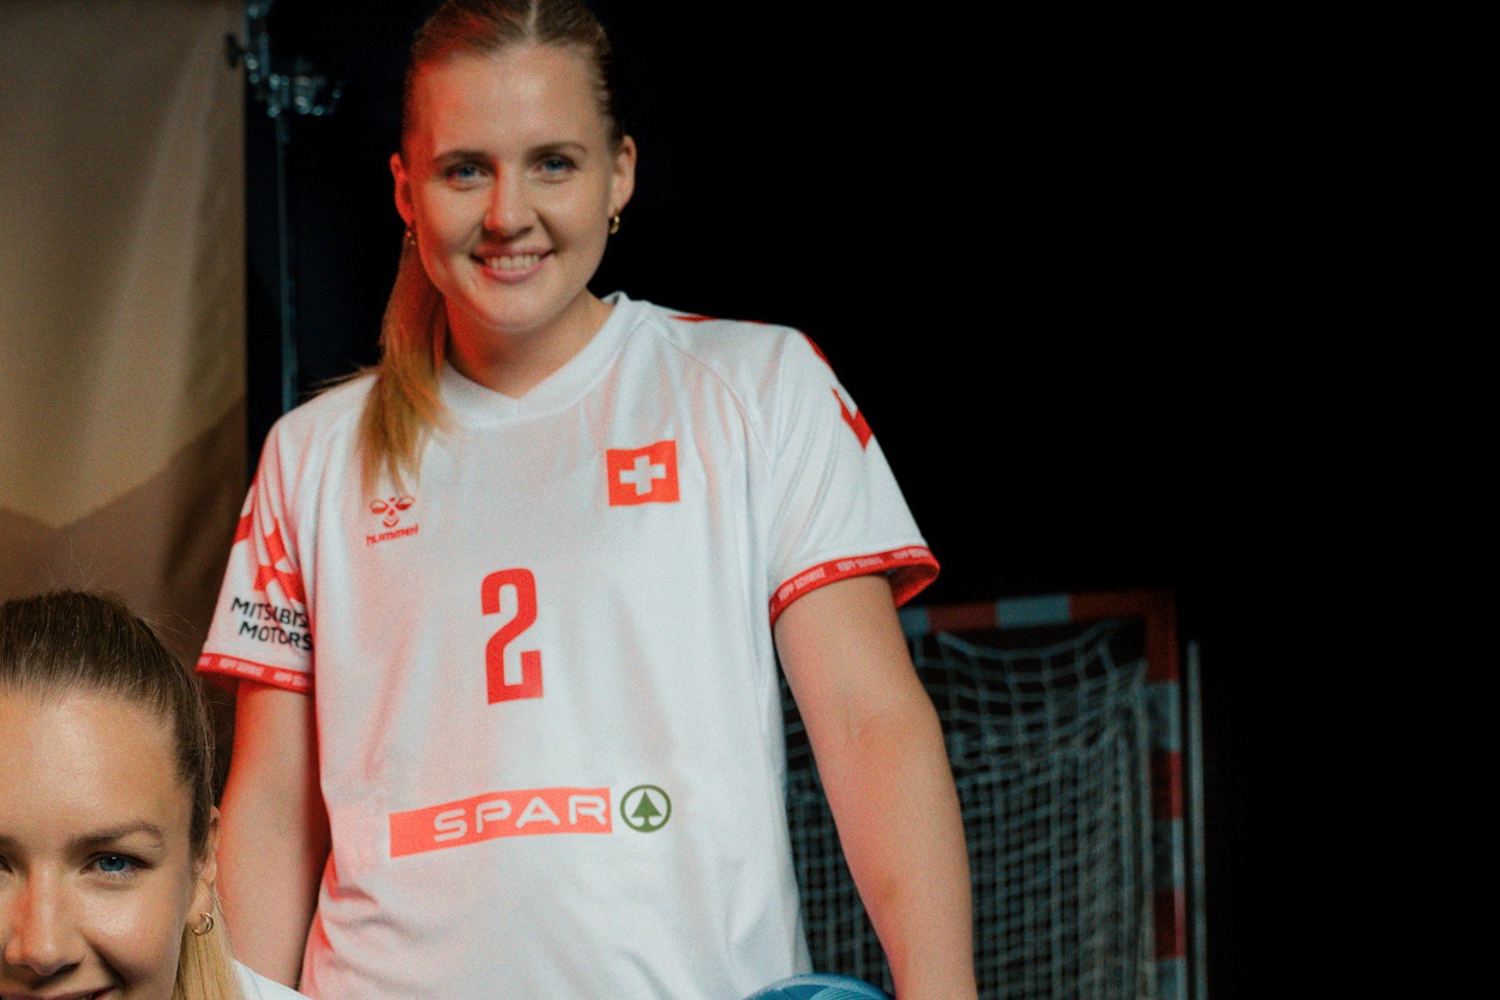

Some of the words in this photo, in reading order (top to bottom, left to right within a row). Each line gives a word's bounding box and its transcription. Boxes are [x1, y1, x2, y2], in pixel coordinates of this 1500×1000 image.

[239, 621, 313, 651] MOTORS
[481, 568, 543, 705] 2
[434, 795, 607, 842] SPAR
